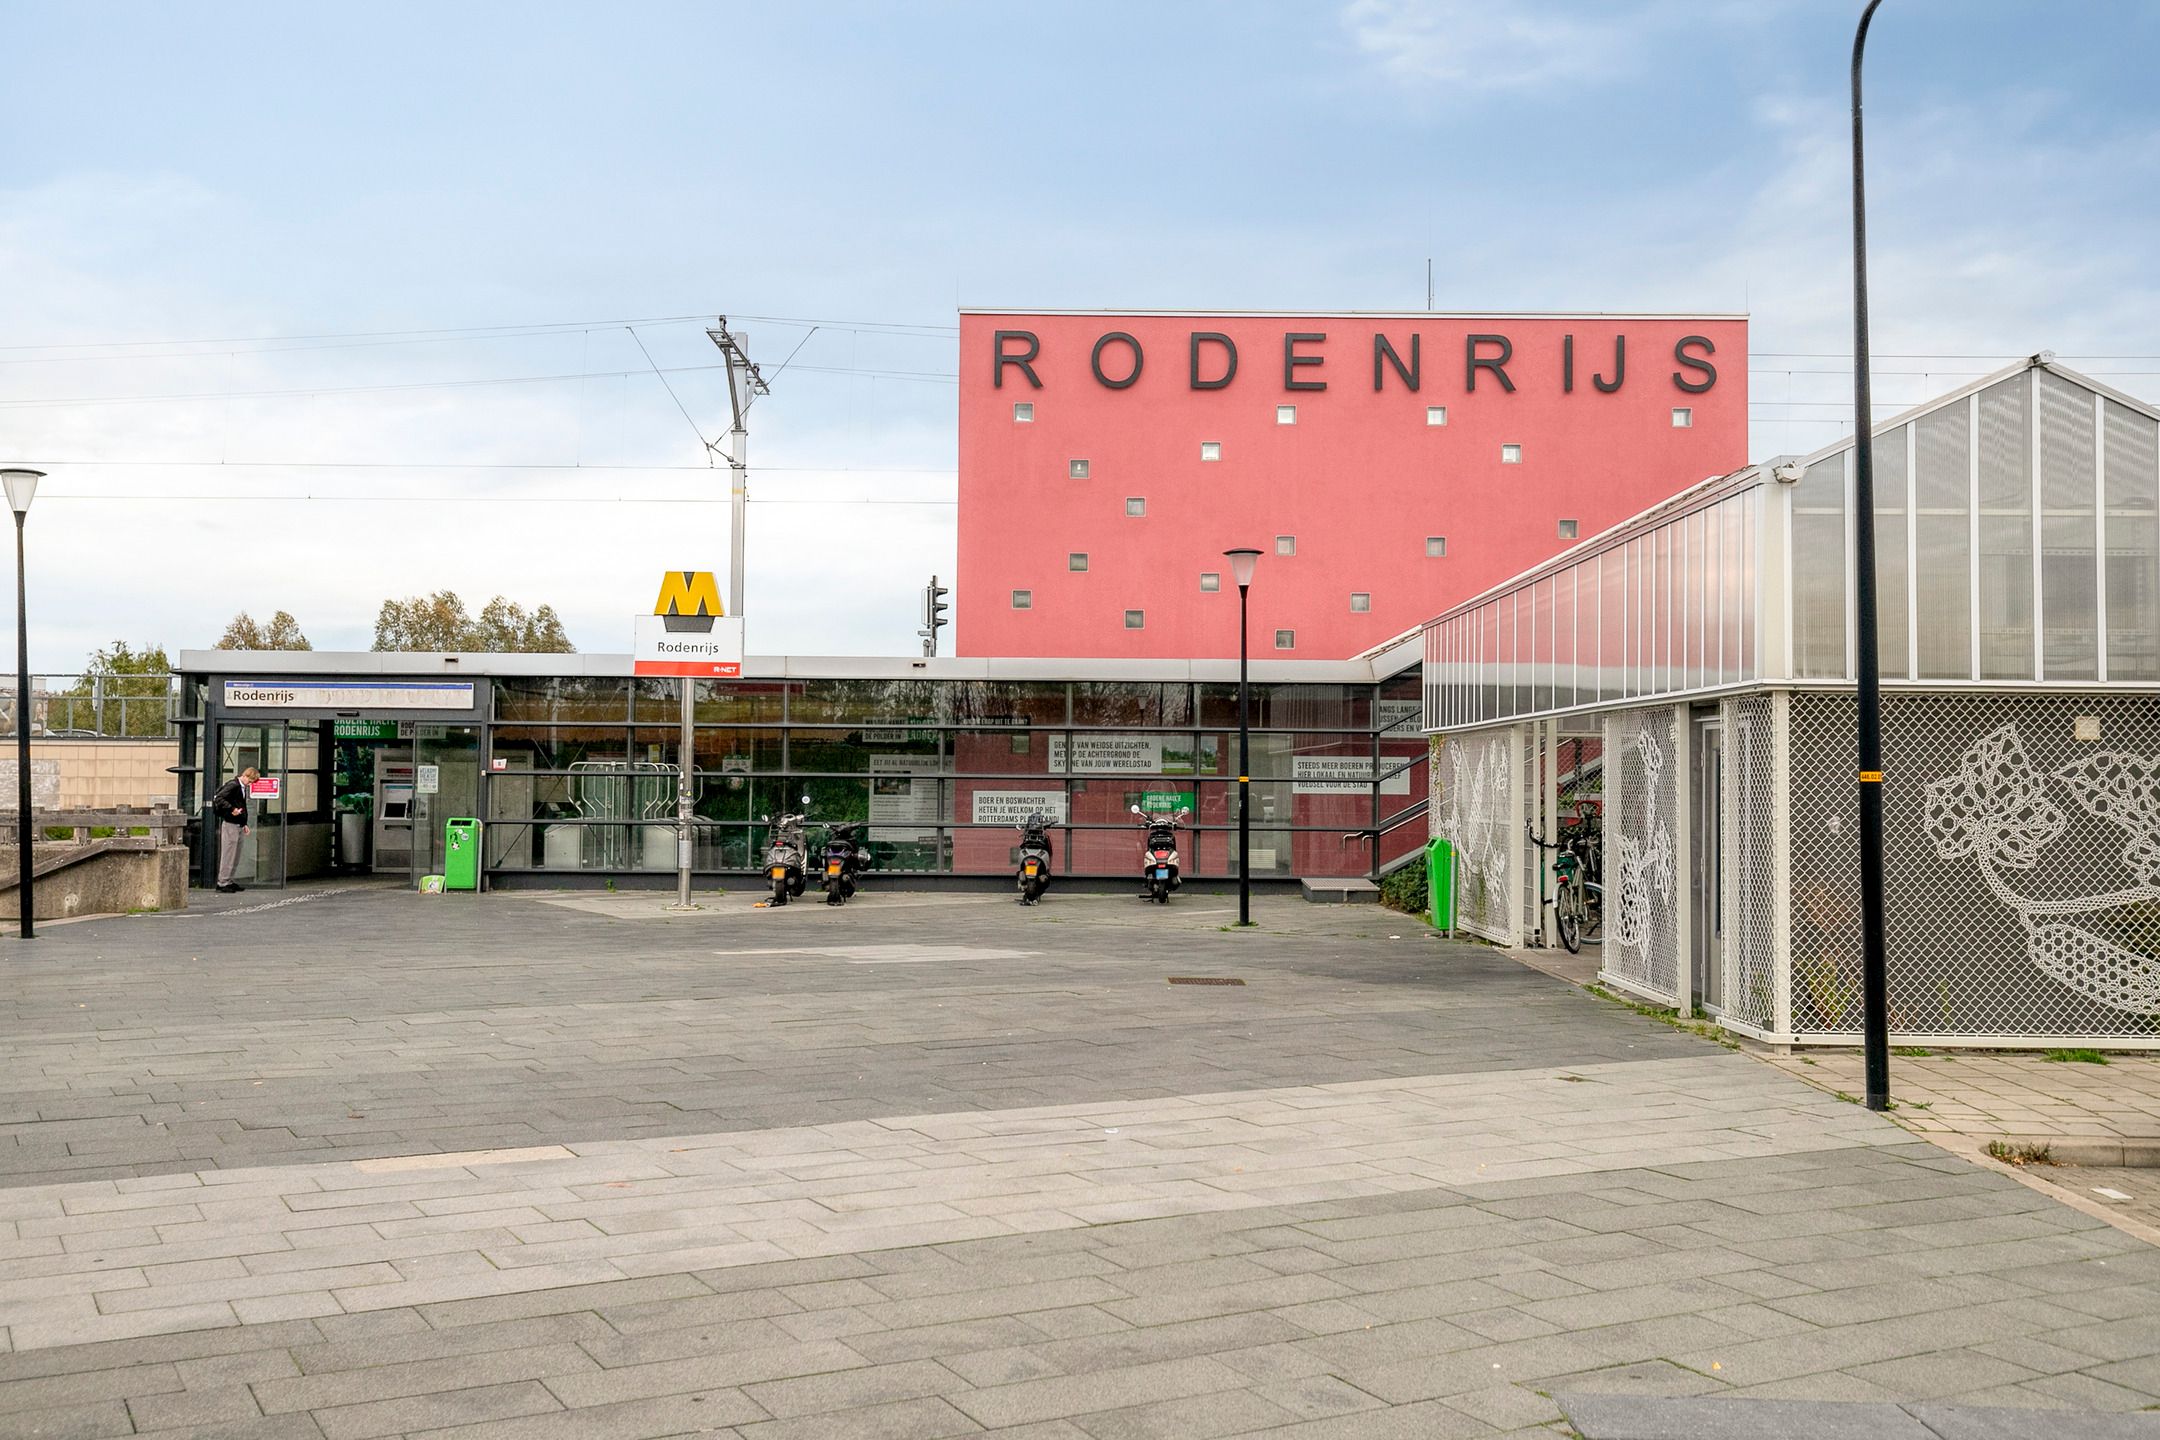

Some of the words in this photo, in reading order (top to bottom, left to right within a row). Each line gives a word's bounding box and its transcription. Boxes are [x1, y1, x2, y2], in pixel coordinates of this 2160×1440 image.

[993, 329, 1719, 393] RODENRIJS
[657, 641, 719, 656] Rodenrijs
[233, 690, 294, 703] Rodenrijs
[334, 725, 380, 737] RODENRIJS
[1054, 741, 1075, 749] GENT
[1077, 741, 1089, 749] VAN
[1091, 741, 1113, 749] WEIDSE
[1114, 741, 1151, 750] UITZICHTEN,
[1054, 759, 1079, 767] SKYNE
[1297, 761, 1320, 770] STEEDS
[1322, 762, 1338, 770] MEER
[1340, 762, 1363, 770] BOEREN
[1297, 771, 1313, 779] HIER
[1314, 771, 1336, 779] LOKAAL
[978, 796, 994, 805] BOER
[996, 796, 1004, 805] EN
[1005, 796, 1046, 805] BOSWACHTER
[978, 806, 998, 814] HETEN
[999, 806, 1007, 814] JE
[1007, 806, 1034, 814] WELKOM
[1045, 806, 1057, 814] HET
[978, 815, 1019, 823] ROTTERDAMS
